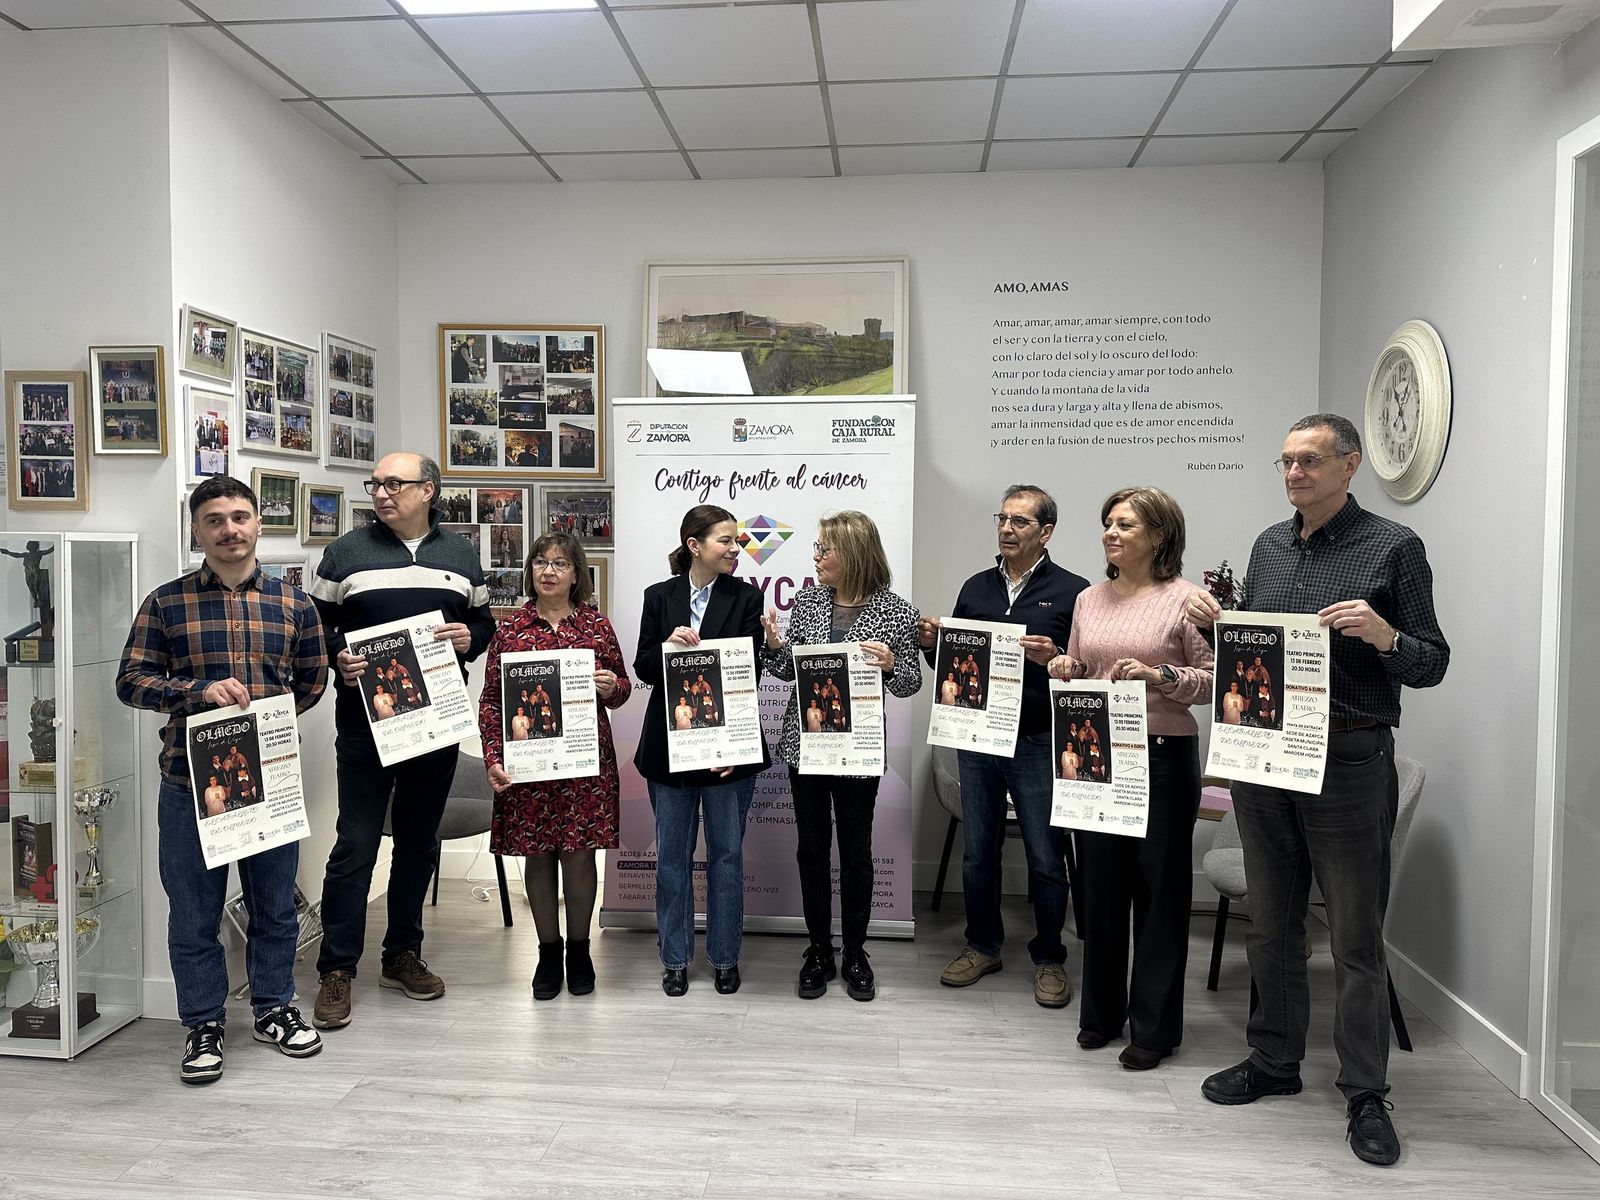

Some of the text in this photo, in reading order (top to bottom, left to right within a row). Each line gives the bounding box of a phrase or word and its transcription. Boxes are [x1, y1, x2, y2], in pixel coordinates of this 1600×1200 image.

[994, 281, 1068, 295] AMO, AMAS
[993, 319, 1022, 328] Amar,
[1025, 320, 1052, 328] amar,
[1055, 318, 1083, 327] amar,
[1085, 318, 1112, 326] amar
[1115, 314, 1160, 327] siempre,
[1186, 313, 1210, 324] todo
[993, 335, 1001, 344] el
[1005, 337, 1021, 345] ser
[1023, 337, 1029, 347] y
[1054, 333, 1061, 343] la
[1065, 333, 1093, 343] tierra
[1096, 336, 1102, 345] y
[1104, 334, 1124, 342] con
[1127, 332, 1136, 342] el
[1139, 332, 1167, 342] cielo,
[993, 348, 1197, 363] con lo claro del sol y lo oscuro del lodo:
[992, 370, 1019, 379] Amar
[1022, 371, 1040, 381] por
[1043, 367, 1066, 378] toda
[1069, 367, 1106, 378] ciencia
[1109, 369, 1115, 379] y
[1147, 369, 1166, 378] por
[1169, 365, 1193, 375] todo
[1197, 365, 1234, 376] anhelo.
[992, 383, 1149, 396] Y cuando la montaña de la vida
[992, 400, 1223, 414] nos sea dura y larga y alta y llena de abismos,
[832, 419, 895, 427] FUNDACON
[991, 421, 1017, 429] amar
[1020, 419, 1028, 429] la
[1031, 418, 1091, 428] inmensidad
[1094, 420, 1113, 429] que
[1131, 417, 1143, 428] de
[1177, 417, 1233, 427] encendida
[1382, 407, 1390, 427] 9
[748, 425, 794, 435] ZAMORA
[832, 428, 895, 437] CAJA RURAL
[646, 434, 691, 443] ZAMORA
[991, 439, 999, 448] ¡y
[1001, 436, 1029, 446] arder
[1047, 435, 1055, 445] la
[1058, 435, 1090, 445] fusión
[1092, 435, 1104, 445] de
[1108, 435, 1154, 445] nuestros
[1157, 433, 1196, 445] pechos
[1199, 433, 1244, 443] mismos!
[1398, 443, 1406, 462] 6
[1188, 461, 1243, 471] Rubén Darío
[655, 463, 868, 502] Contigo frente al cáncer
[945, 633, 986, 646] OLMEDO
[1224, 631, 1277, 645] OLMEDO
[359, 637, 405, 656] OLMEDO
[671, 656, 715, 668] OLMEDO
[801, 659, 842, 670] OLMEDO
[510, 666, 554, 678] OLMEDO
[1059, 697, 1103, 709] OLMEDO
[197, 722, 250, 742] OLMEDO
[274, 725, 294, 734] PRINCIPAL
[274, 732, 291, 740] FEBRERO
[278, 738, 291, 746] HORAS
[1300, 738, 1325, 746] MUNICIPAL
[262, 757, 281, 766] DONATIVO
